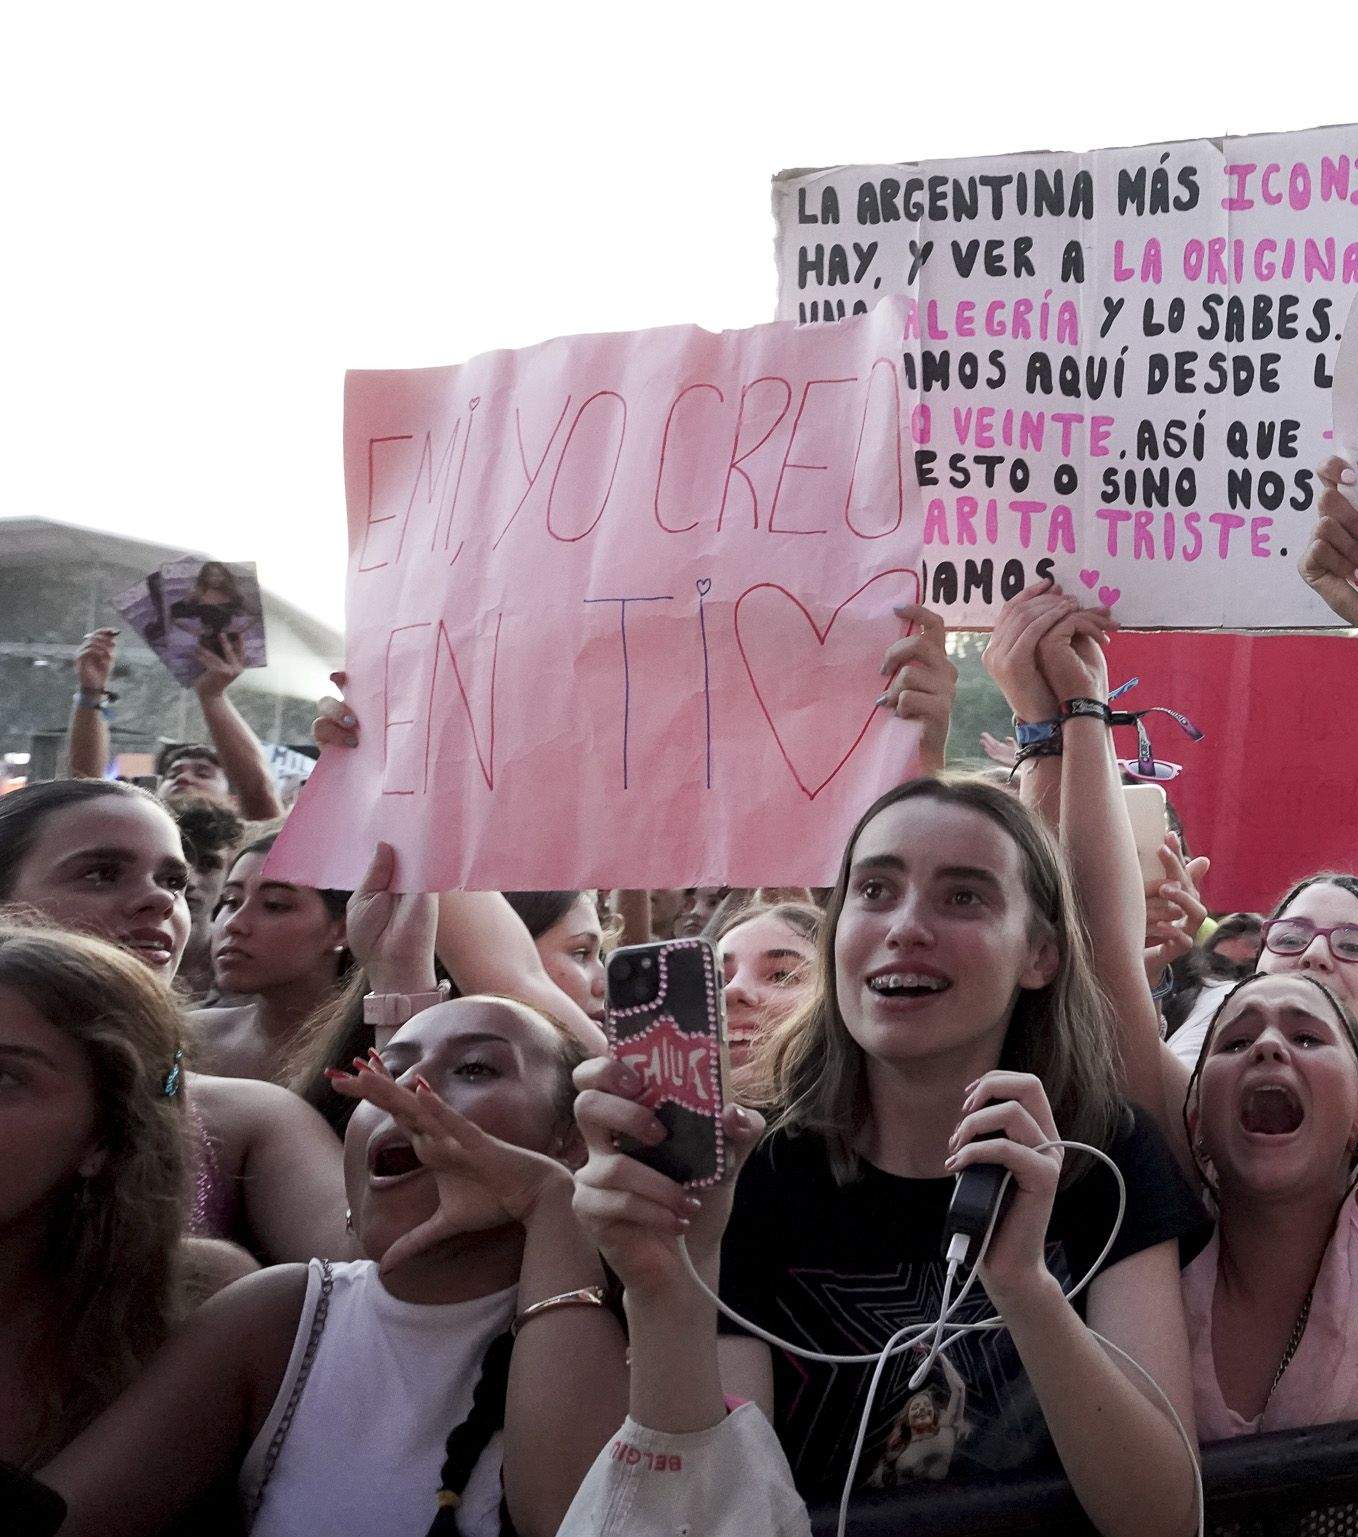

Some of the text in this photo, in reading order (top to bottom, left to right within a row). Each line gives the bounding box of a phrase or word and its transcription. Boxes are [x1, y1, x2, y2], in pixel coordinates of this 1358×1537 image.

[798, 186, 841, 225] LA
[857, 168, 1094, 224] ARGENTINA
[1118, 152, 1199, 216] MÁS
[799, 240, 882, 290] HAY,
[908, 240, 934, 286] Y
[951, 236, 1036, 279] VER
[1062, 240, 1084, 283] A
[1114, 236, 1163, 283] LA
[903, 289, 1080, 346] ALEGRÍA
[1100, 296, 1125, 339] Y
[1143, 299, 1186, 340] LO
[1197, 294, 1342, 343] SABES.
[1026, 346, 1128, 399] AQUÍ
[1147, 350, 1282, 396] DESDE
[492, 391, 627, 551] YO
[654, 357, 903, 540] CREO
[1137, 409, 1206, 461] ASÍ
[1227, 419, 1301, 460] QUE
[1053, 463, 1078, 496] O
[1100, 466, 1197, 508] SINO
[1227, 468, 1314, 511] NOS
[1096, 508, 1289, 563] TRISTE.
[922, 557, 1056, 606] AMOS
[382, 612, 503, 796] EN
